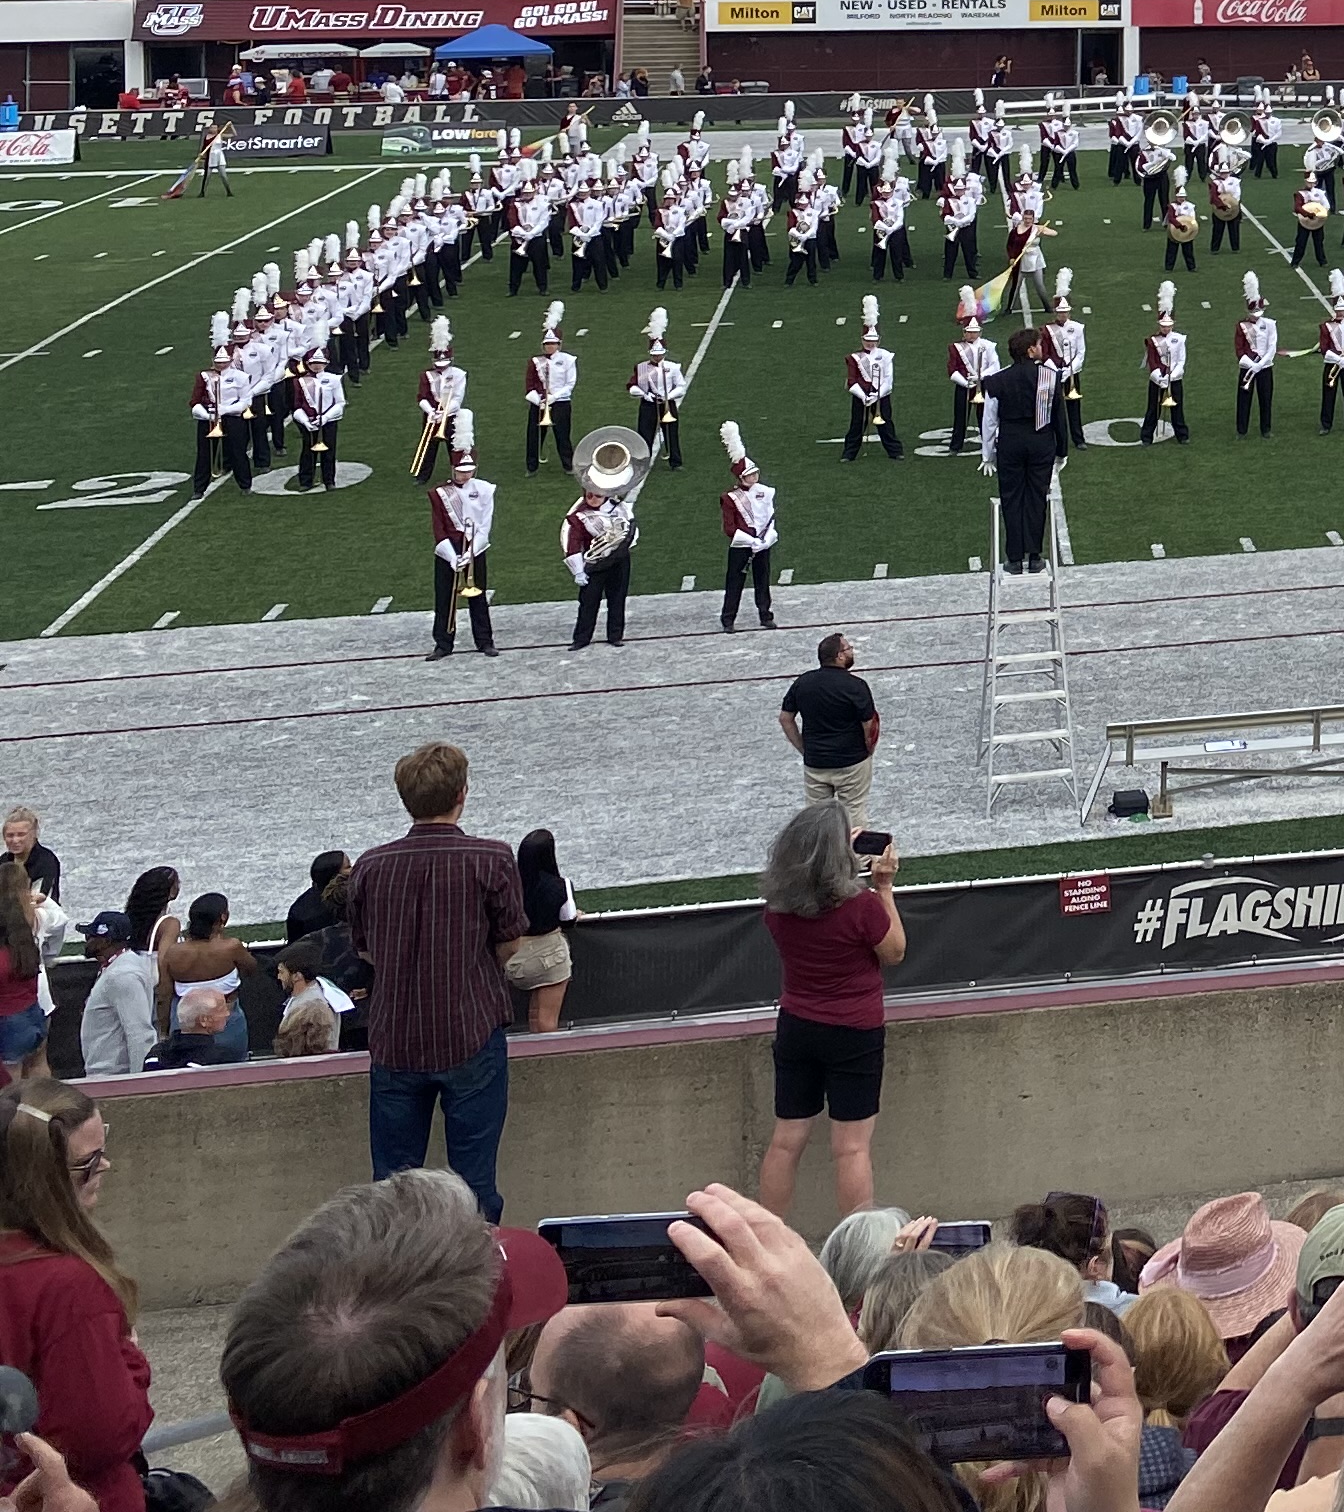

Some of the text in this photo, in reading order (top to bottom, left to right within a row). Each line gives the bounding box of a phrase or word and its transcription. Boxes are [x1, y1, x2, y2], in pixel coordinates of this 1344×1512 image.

[521, 0, 597, 18] GO! GO U!
[840, 0, 1007, 10] NEW USED RENTALS
[1040, 4, 1120, 17] Milton CAT
[369, 4, 484, 29] DINING
[513, 9, 609, 29] GO UMASS!
[730, 6, 815, 20] Milton CAT
[432, 128, 500, 141] LOWfare
[220, 134, 323, 151] cketSmarter
[1078, 879, 1092, 888] NO
[1063, 885, 1107, 897] STANDING
[1070, 894, 1101, 904] ALONG
[1064, 900, 1108, 913] FENCE LINE
[1319, 1248, 1339, 1262] Band
